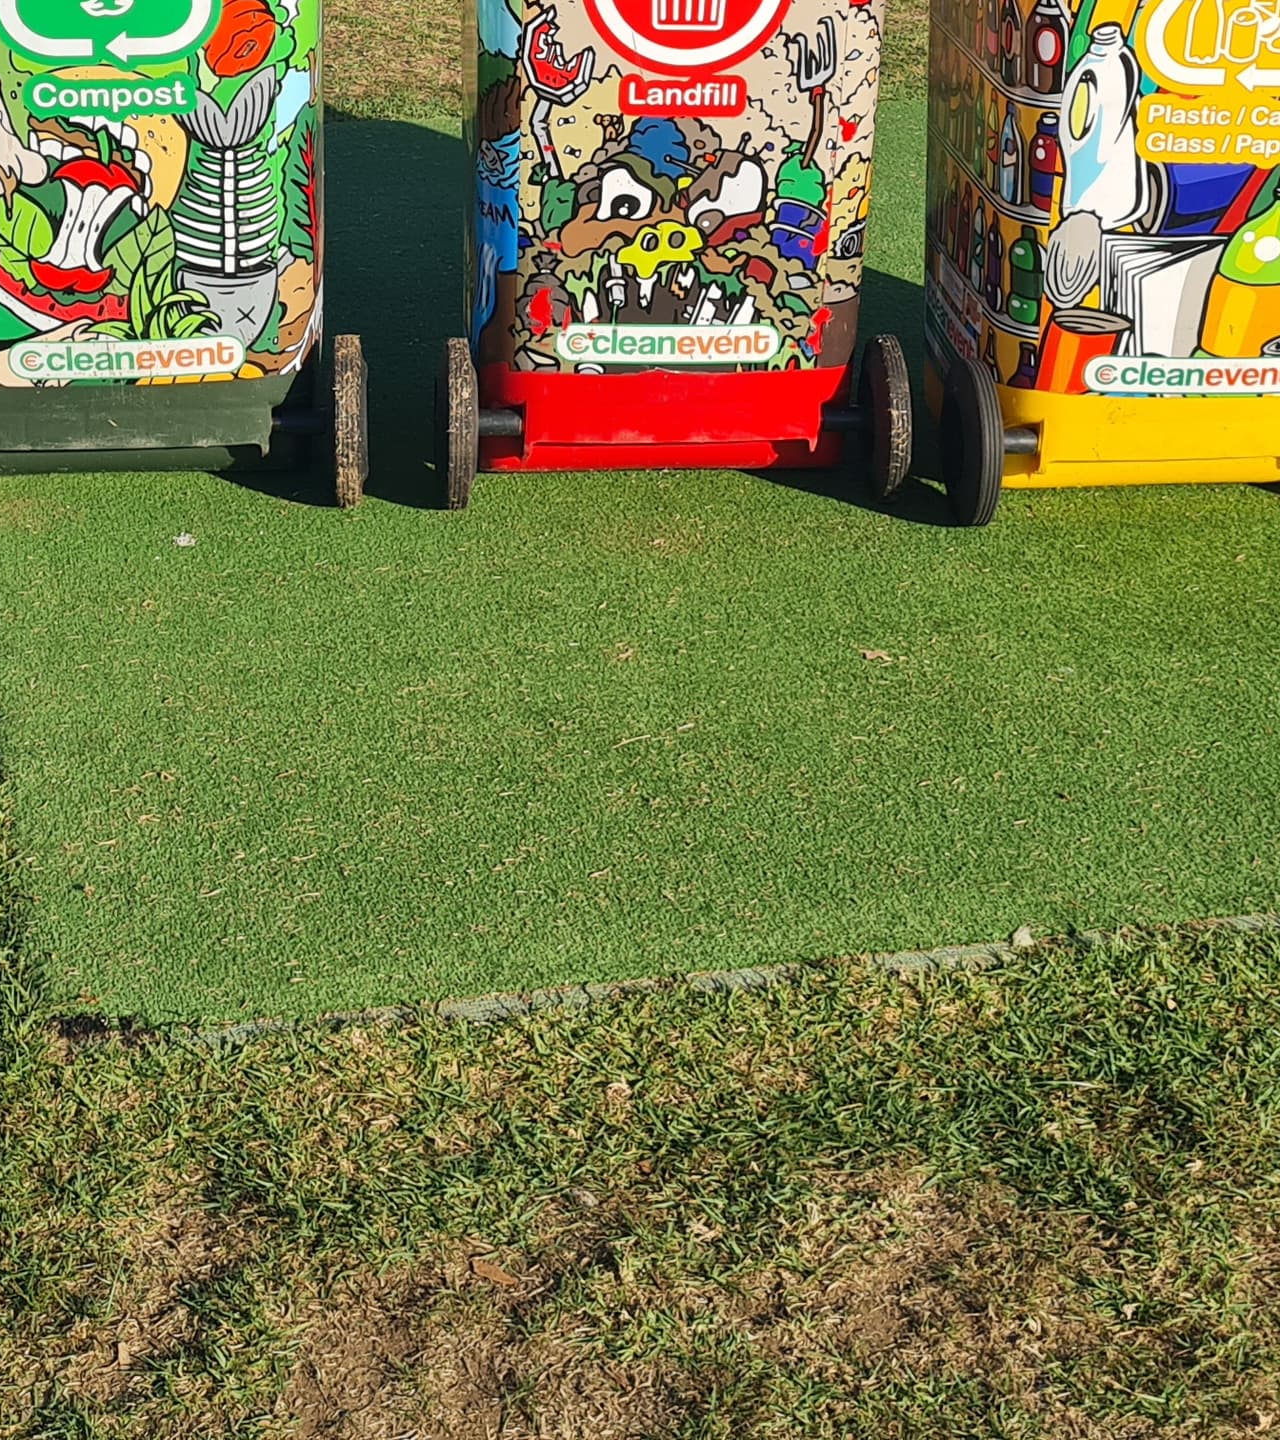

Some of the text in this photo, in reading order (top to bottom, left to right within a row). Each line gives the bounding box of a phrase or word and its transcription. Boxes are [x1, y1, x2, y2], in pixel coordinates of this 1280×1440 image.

[32, 81, 187, 113] Compost
[628, 81, 738, 107] Landfill
[1148, 103, 1231, 126] Plastic
[1146, 132, 1216, 153] Glass
[592, 329, 770, 356] cleanevent
[46, 341, 234, 372] cleanevent
